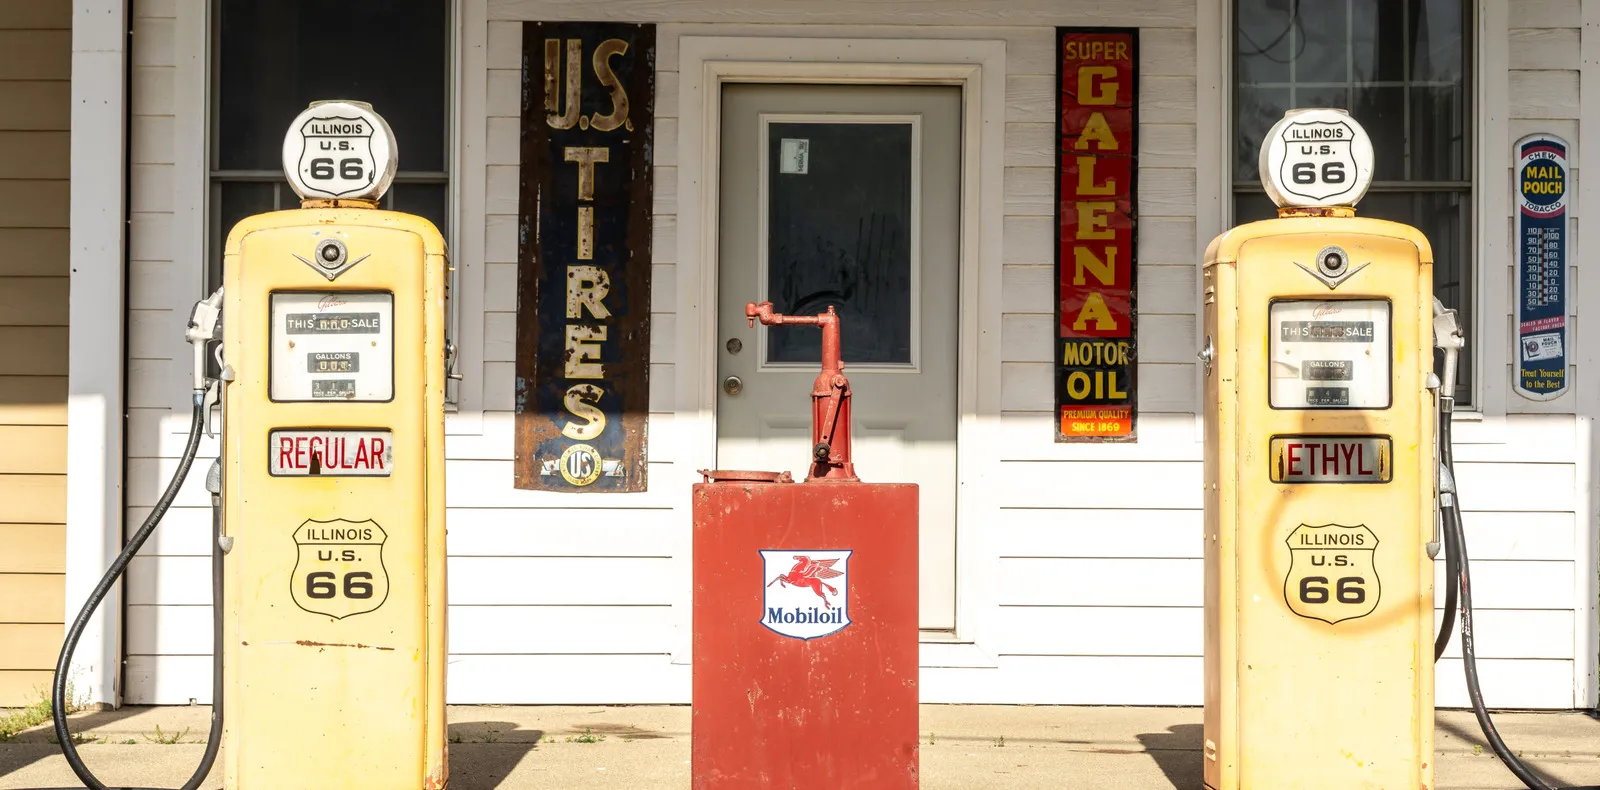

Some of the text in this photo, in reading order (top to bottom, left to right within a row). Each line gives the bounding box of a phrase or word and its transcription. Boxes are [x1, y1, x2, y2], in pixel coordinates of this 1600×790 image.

[1065, 41, 1129, 60] SUPER
[544, 38, 635, 131] U.S.
[311, 123, 363, 135] ILLINOIS
[1292, 128, 1343, 139] ILLINOIS
[320, 141, 355, 151] U.S.
[1301, 145, 1336, 155] U.S.
[1528, 152, 1556, 161] CHEW
[310, 158, 364, 180] 66
[1292, 162, 1346, 184] 66
[1526, 166, 1562, 179] MAIL
[1523, 181, 1563, 194] POUCH
[1073, 66, 1119, 330] GALENA
[1525, 201, 1561, 212] TOBACCO
[561, 147, 612, 441] TIRES
[288, 319, 314, 329] THIS
[351, 319, 379, 328] SALE
[1283, 327, 1309, 336] THIS
[1346, 327, 1373, 336] SALE
[1063, 342, 1129, 366] MOTOR
[1521, 369, 1564, 378] Treat Yourself
[1066, 371, 1127, 400] OIL
[1526, 380, 1560, 388] to the Best
[1063, 410, 1129, 420] PREMIUM QUALITY
[1071, 422, 1120, 432] SINCE 1869
[280, 437, 385, 469] REGULAR
[570, 451, 591, 478] US
[1288, 443, 1373, 476] ETHYL
[307, 529, 372, 540] ILLINOIS
[1301, 534, 1364, 545] ILLINOIS
[318, 550, 362, 561] U.S.
[1312, 555, 1354, 566] U.S.
[306, 571, 373, 599] 66
[1300, 576, 1366, 604] 66
[768, 607, 842, 624] Mobiloil
